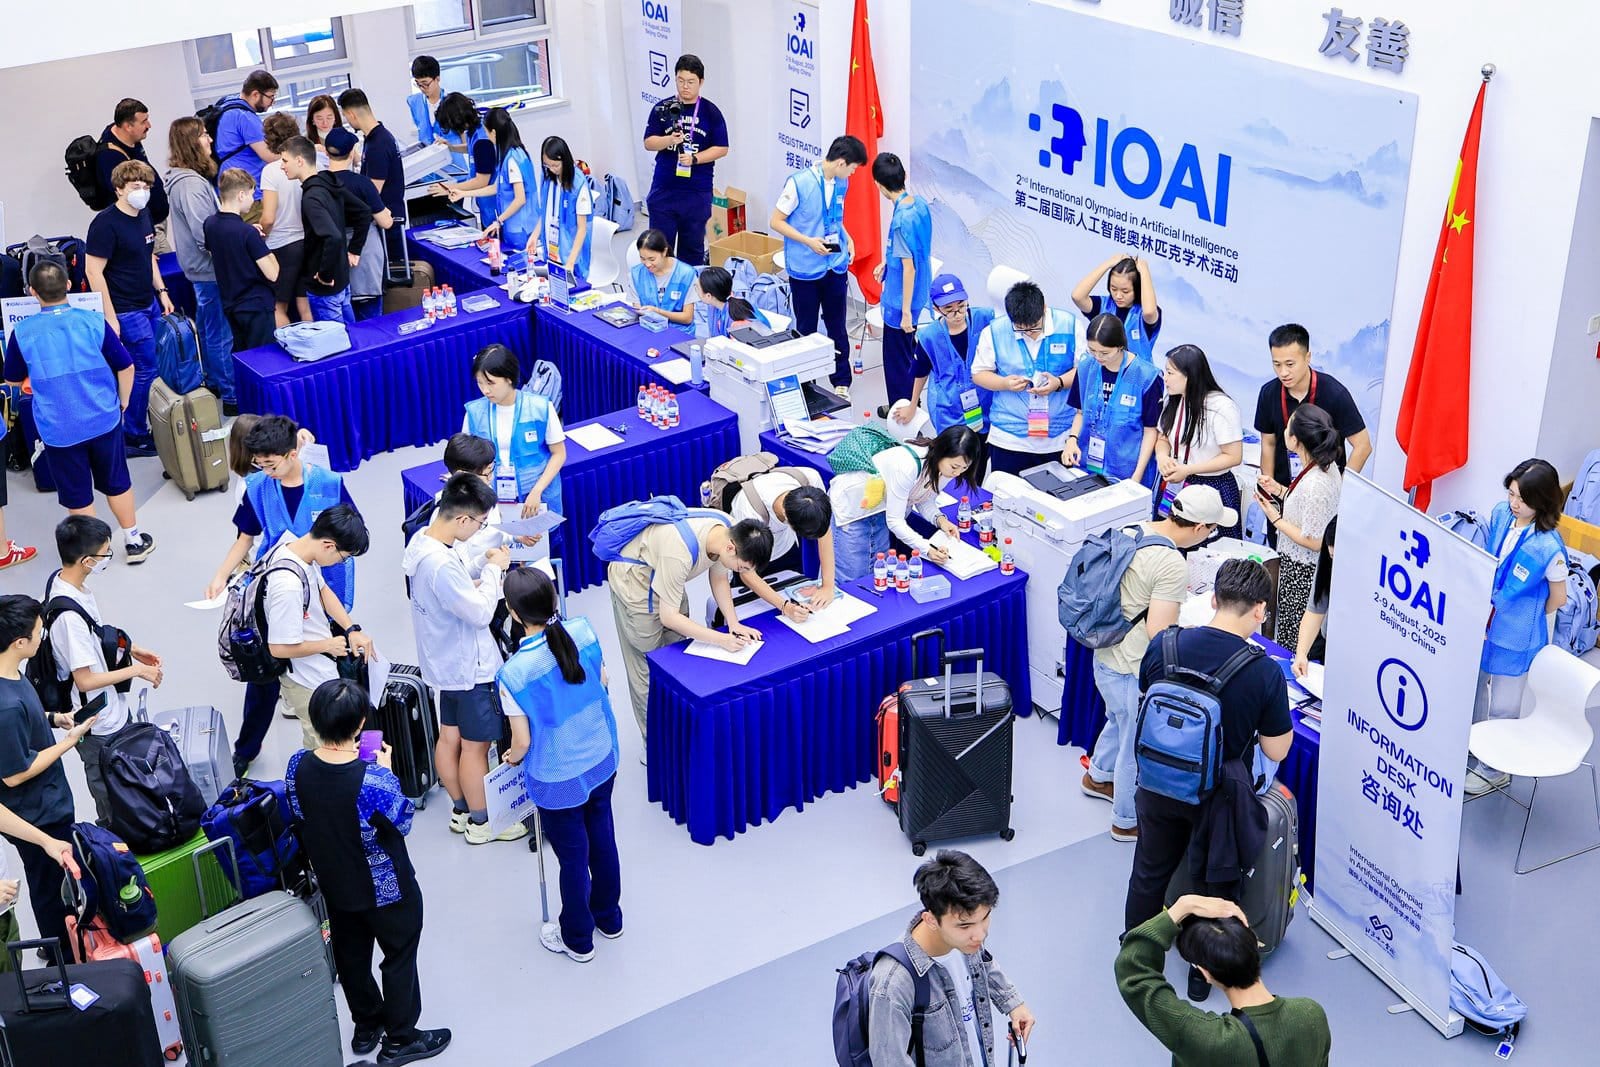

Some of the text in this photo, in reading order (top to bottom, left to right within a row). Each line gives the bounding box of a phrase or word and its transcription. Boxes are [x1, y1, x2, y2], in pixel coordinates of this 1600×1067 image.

[642, 0, 668, 23] IOAI
[1317, 7, 1410, 73] 友善
[787, 32, 813, 59] IOAI
[1094, 117, 1232, 227] IOAI
[1015, 189, 1239, 283] 第二届国际人工智能奥林匹克学术活动
[1016, 174, 1239, 260] 2nd International Olympiad in Artificial Intelligence
[1374, 592, 1447, 646] 2-9 August, 2025
[1379, 554, 1446, 626] IOAI
[499, 777, 518, 794] Hong
[1347, 708, 1453, 798] INFORMATION
[1377, 755, 1417, 798] DESK
[1361, 769, 1424, 840] 咨询处
[1349, 854, 1422, 920] in Artificial Intelligence
[1350, 844, 1423, 910] International Olympiad
